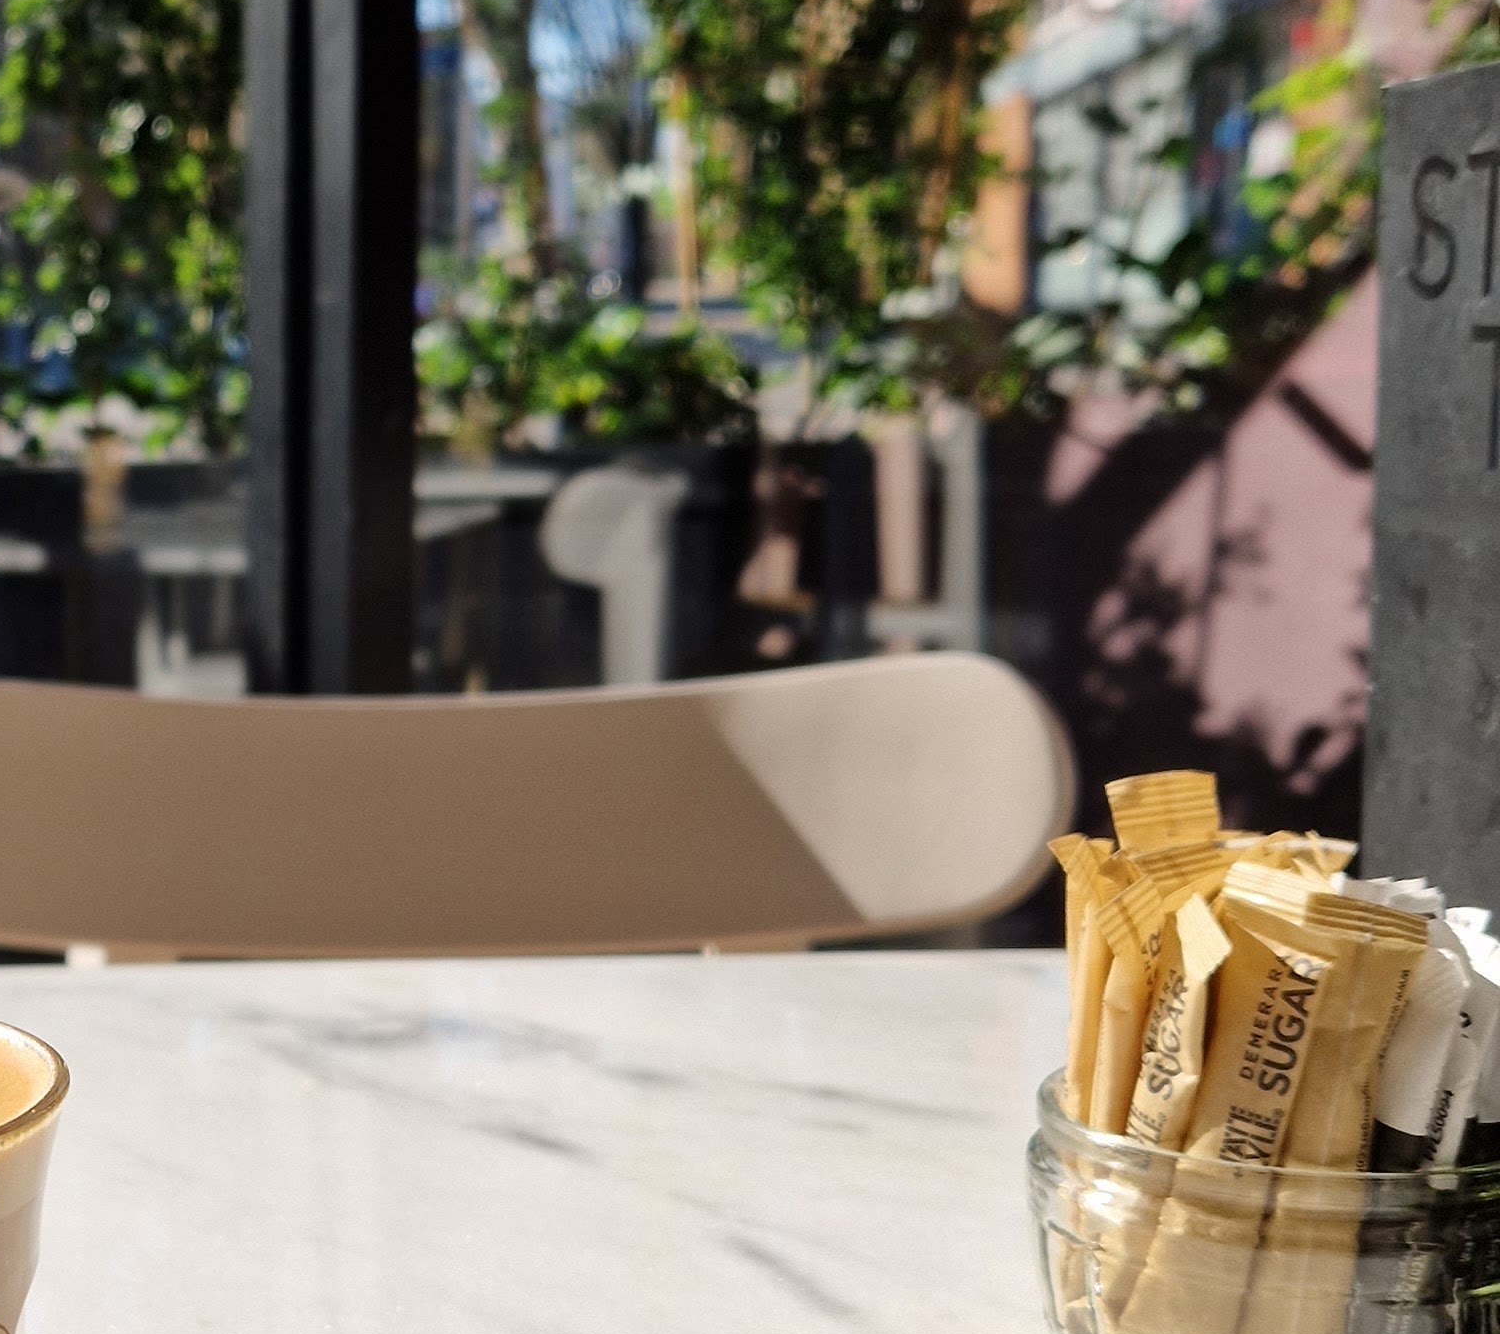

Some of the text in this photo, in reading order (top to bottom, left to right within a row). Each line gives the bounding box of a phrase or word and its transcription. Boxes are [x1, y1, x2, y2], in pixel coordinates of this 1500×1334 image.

[1147, 974, 1189, 1101] SUGAR
[1239, 955, 1290, 1081] DEMERARA
[1258, 958, 1329, 1097] SUGAR
